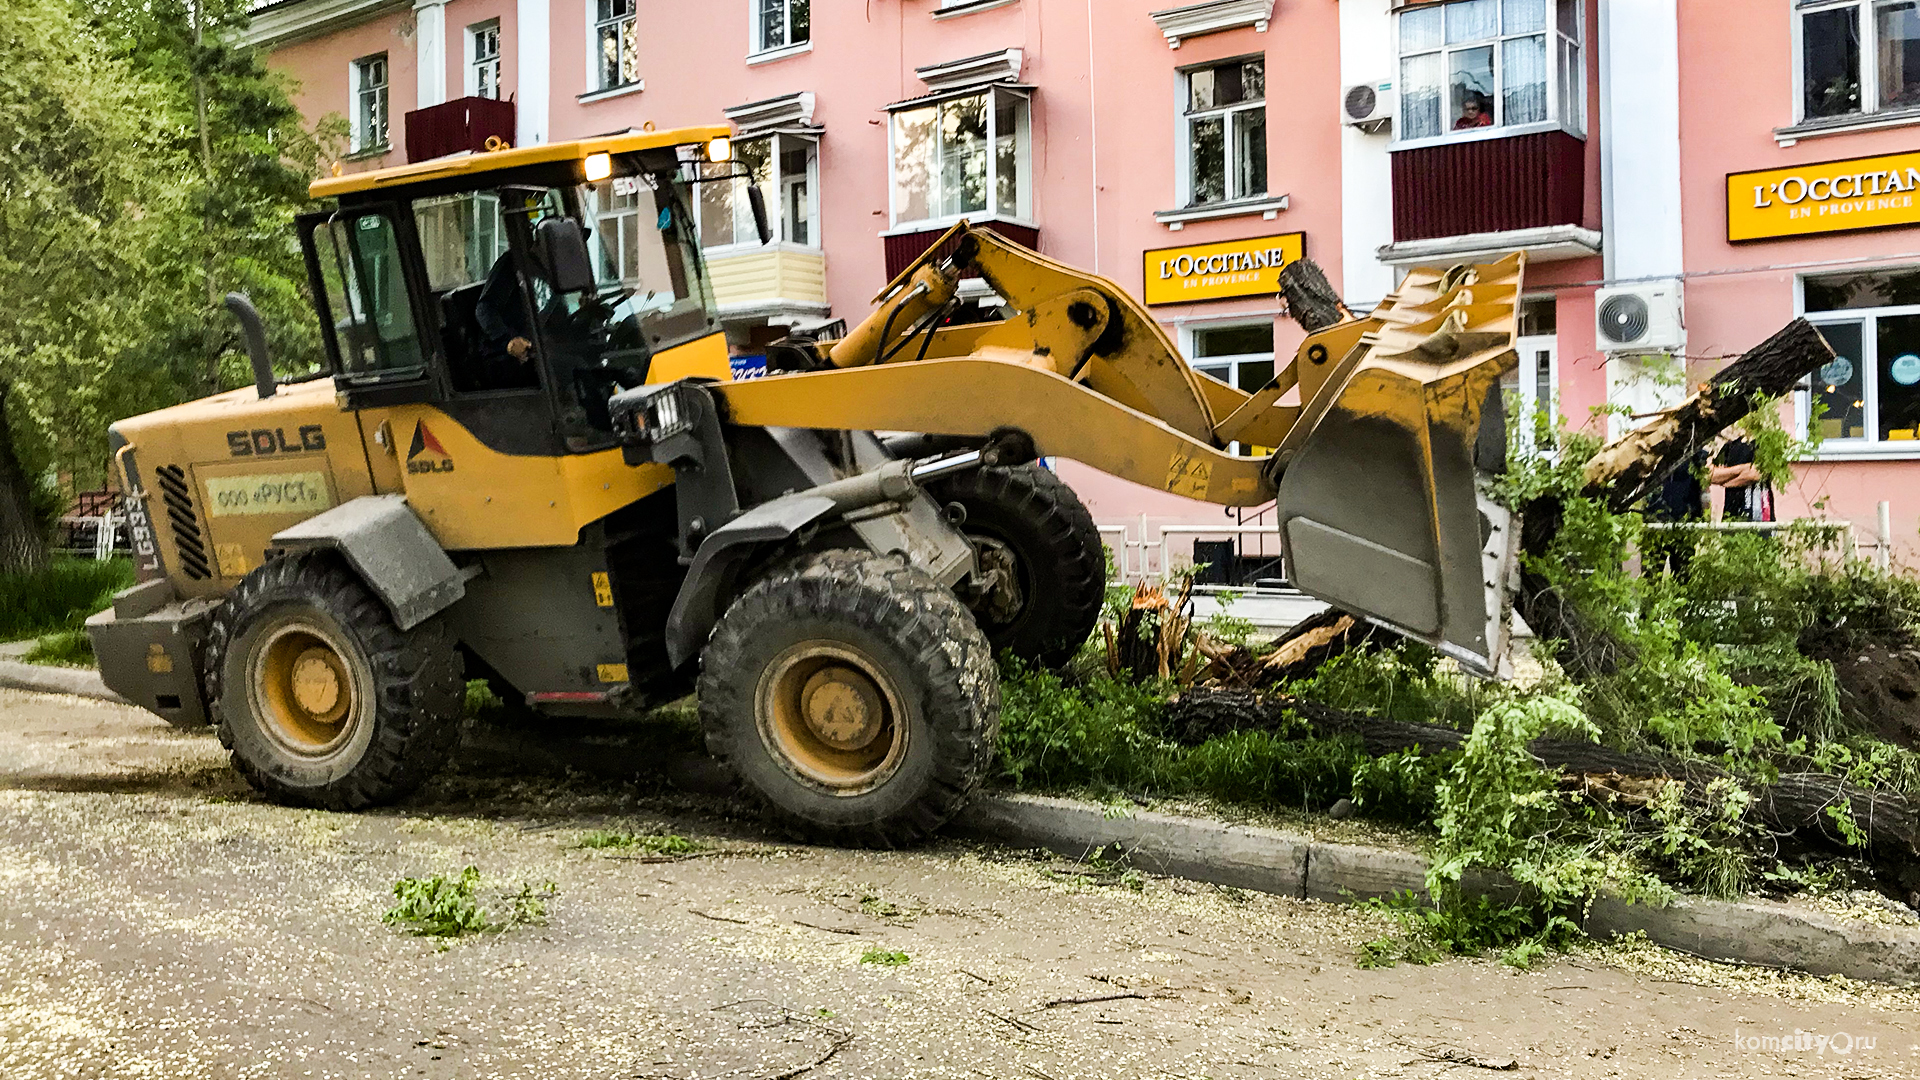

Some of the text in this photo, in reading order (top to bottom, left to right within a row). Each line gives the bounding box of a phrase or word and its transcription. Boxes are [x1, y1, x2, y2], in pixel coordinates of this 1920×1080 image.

[1789, 195, 1914, 220] EN PROVENCE
[1159, 247, 1284, 280] L'OCCITANE
[1184, 272, 1260, 289] EN PROVENCE
[226, 423, 327, 457] SDLG
[406, 458, 455, 475] SDLG
